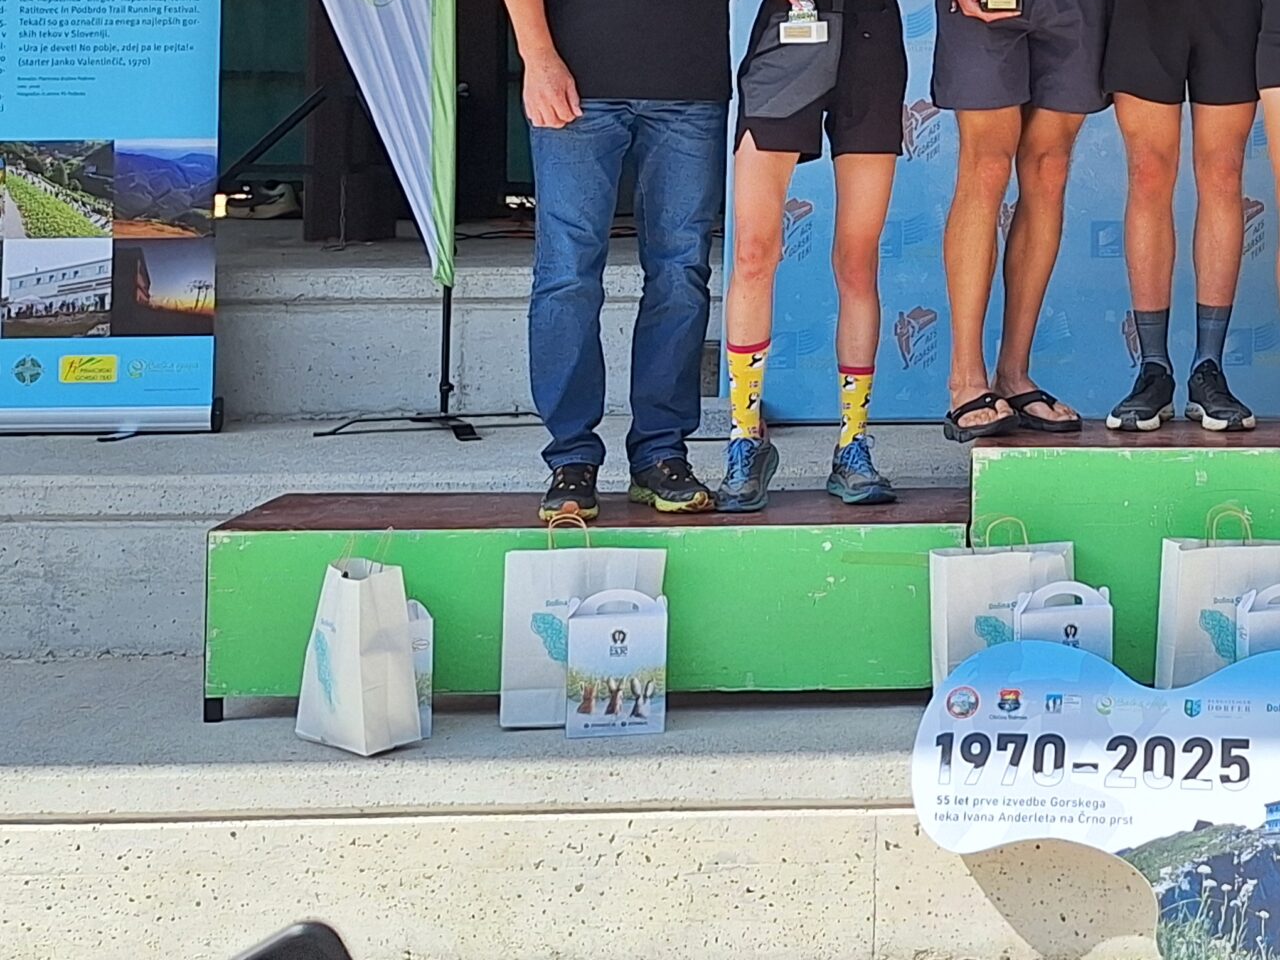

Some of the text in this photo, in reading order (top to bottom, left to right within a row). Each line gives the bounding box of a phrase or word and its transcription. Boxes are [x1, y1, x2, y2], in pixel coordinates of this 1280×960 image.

[936, 795, 1106, 810] 55 let prve izvedbe Gorskega
[934, 810, 1133, 827] teka Ivana Anderleta na Črno prst
